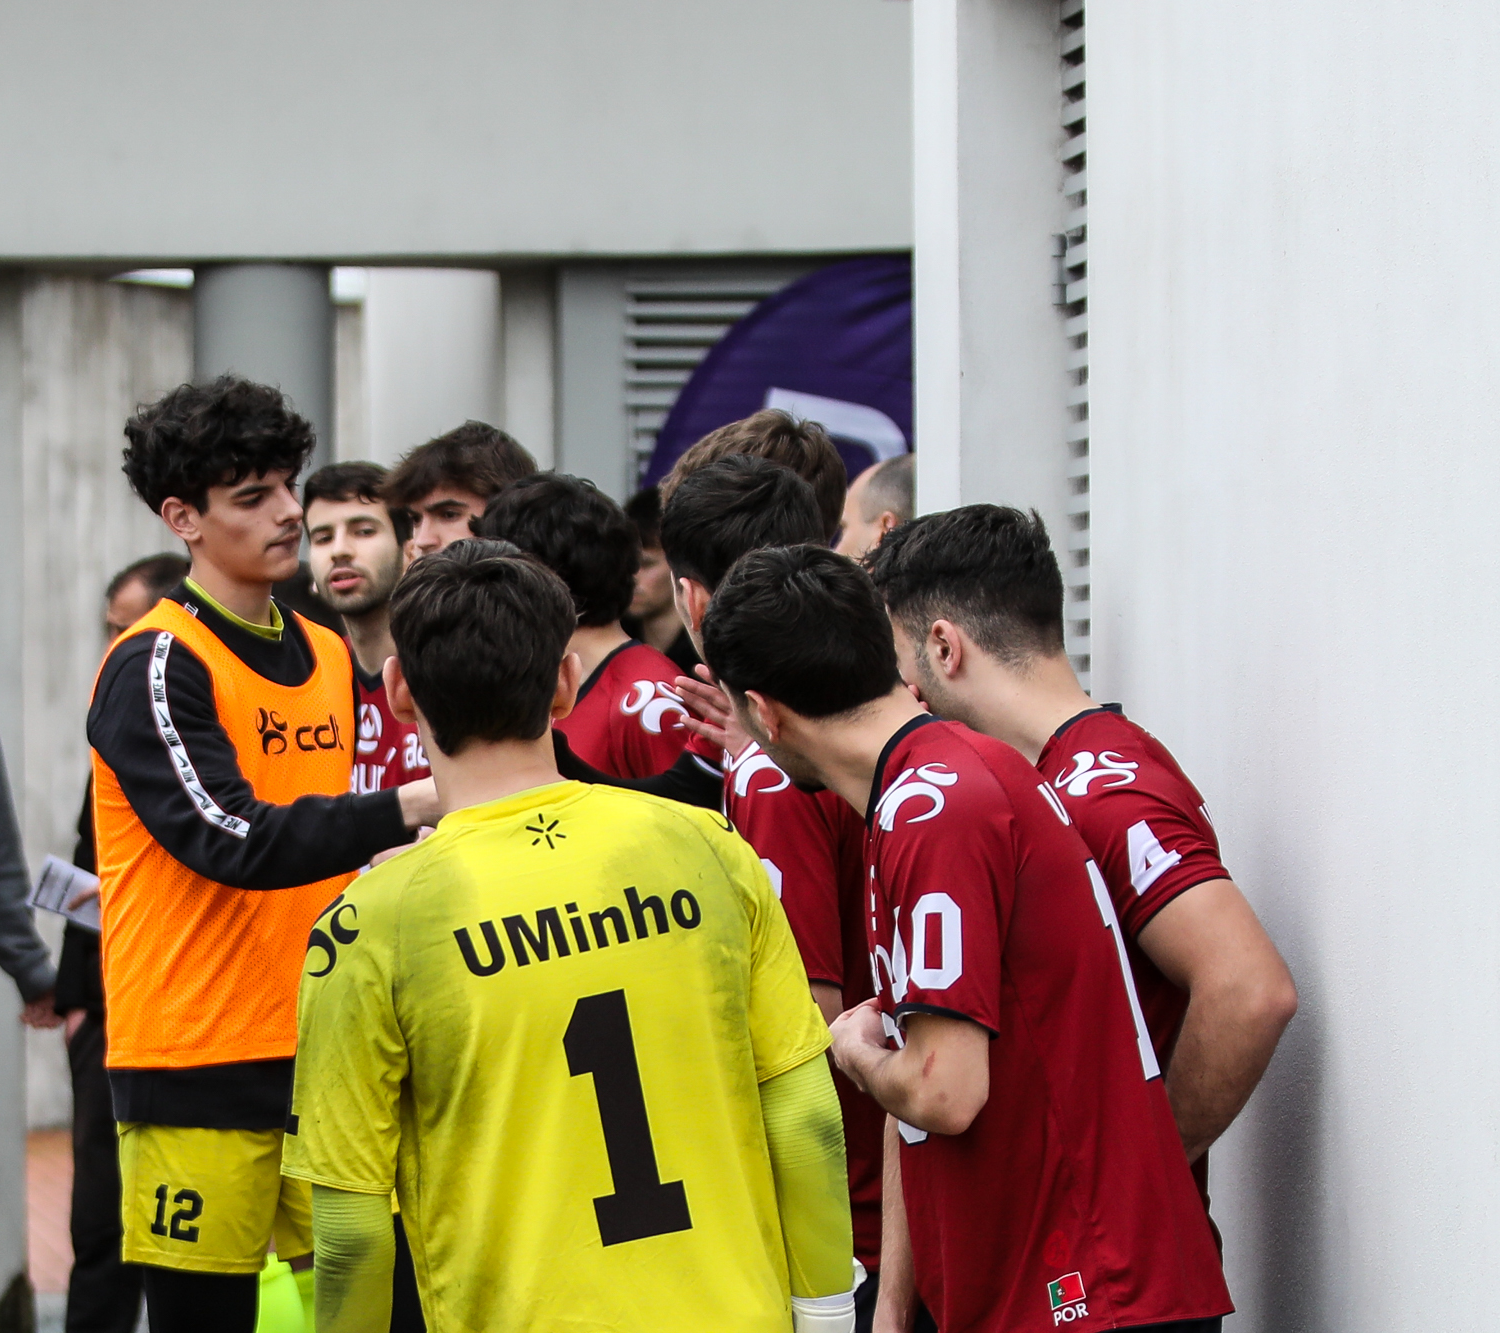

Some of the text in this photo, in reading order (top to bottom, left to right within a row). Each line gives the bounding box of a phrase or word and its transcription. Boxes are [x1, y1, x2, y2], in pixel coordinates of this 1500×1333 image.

[152, 682, 166, 703] NIKE
[452, 885, 702, 978] UMinho
[562, 988, 694, 1248] 1
[151, 1183, 204, 1243] 12
[1053, 1302, 1090, 1328] POR
